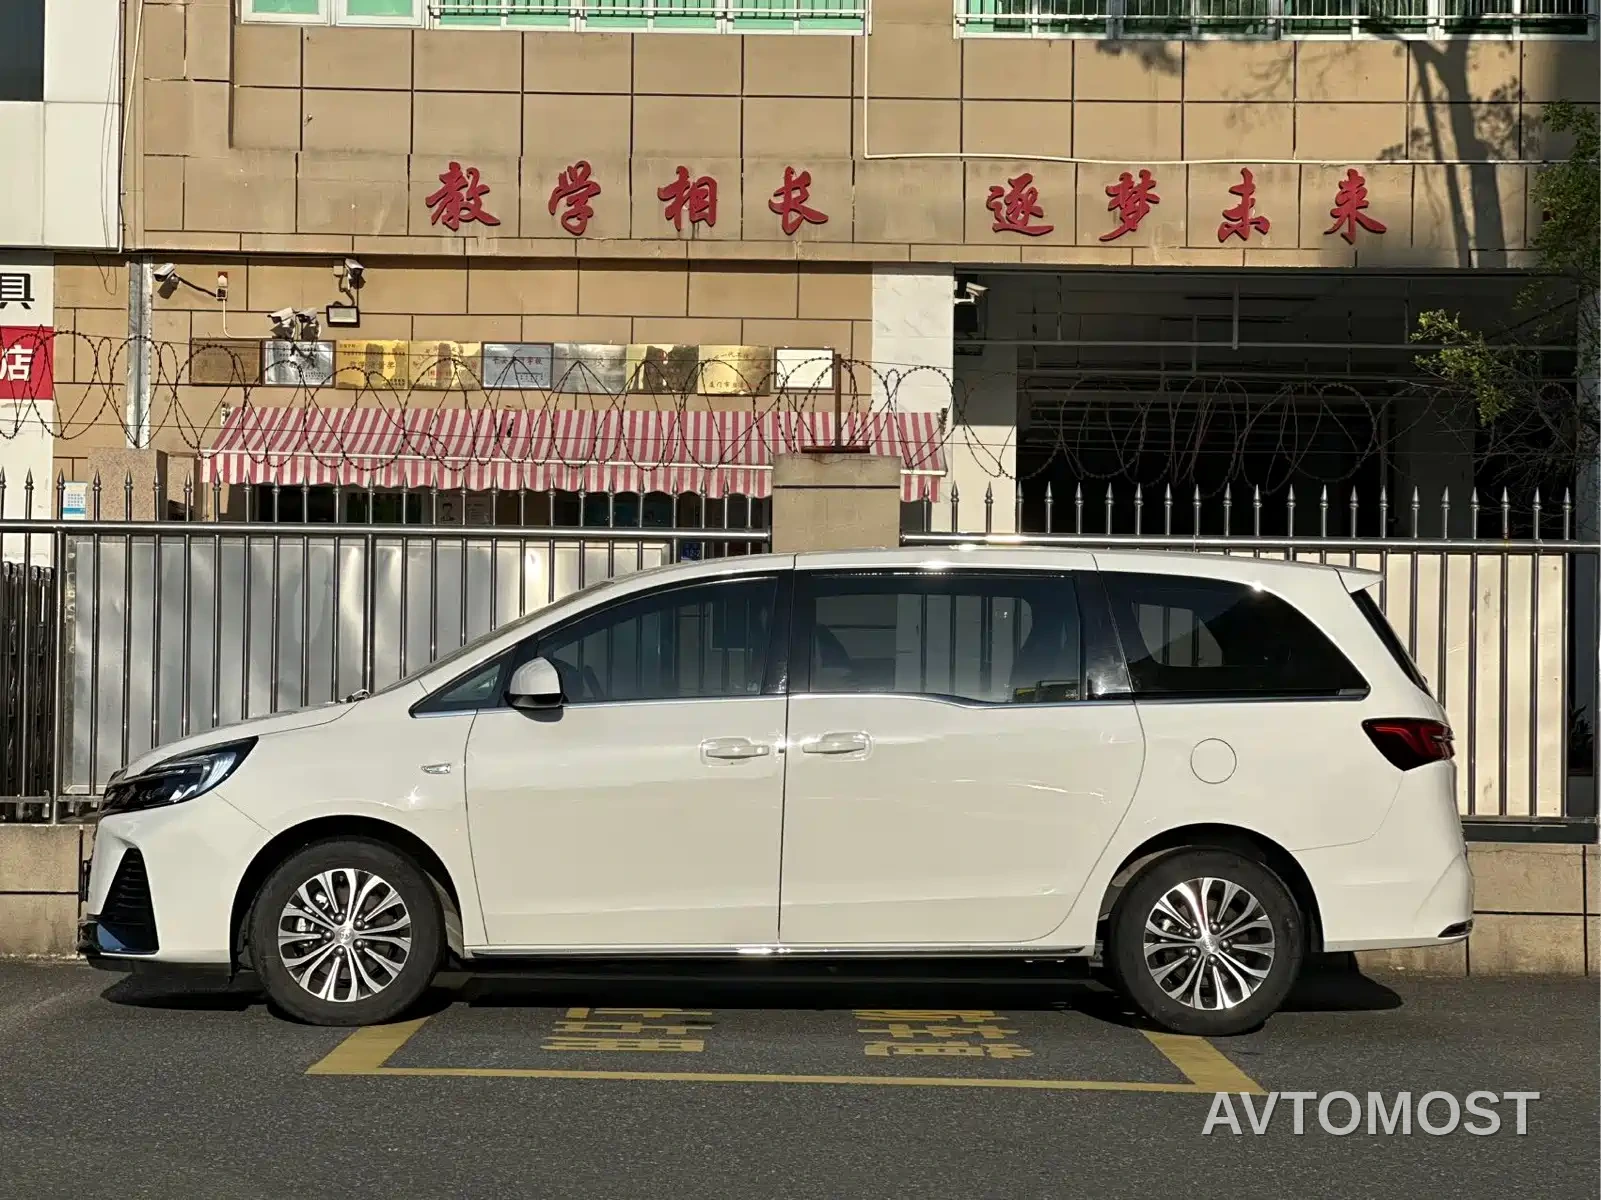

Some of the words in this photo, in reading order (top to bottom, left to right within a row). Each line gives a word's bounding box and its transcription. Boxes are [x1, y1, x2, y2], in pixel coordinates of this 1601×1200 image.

[426, 161, 829, 236] 教学相长
[987, 168, 1387, 243] 逐梦未来
[0, 272, 35, 310] 具
[0, 344, 33, 382] 店
